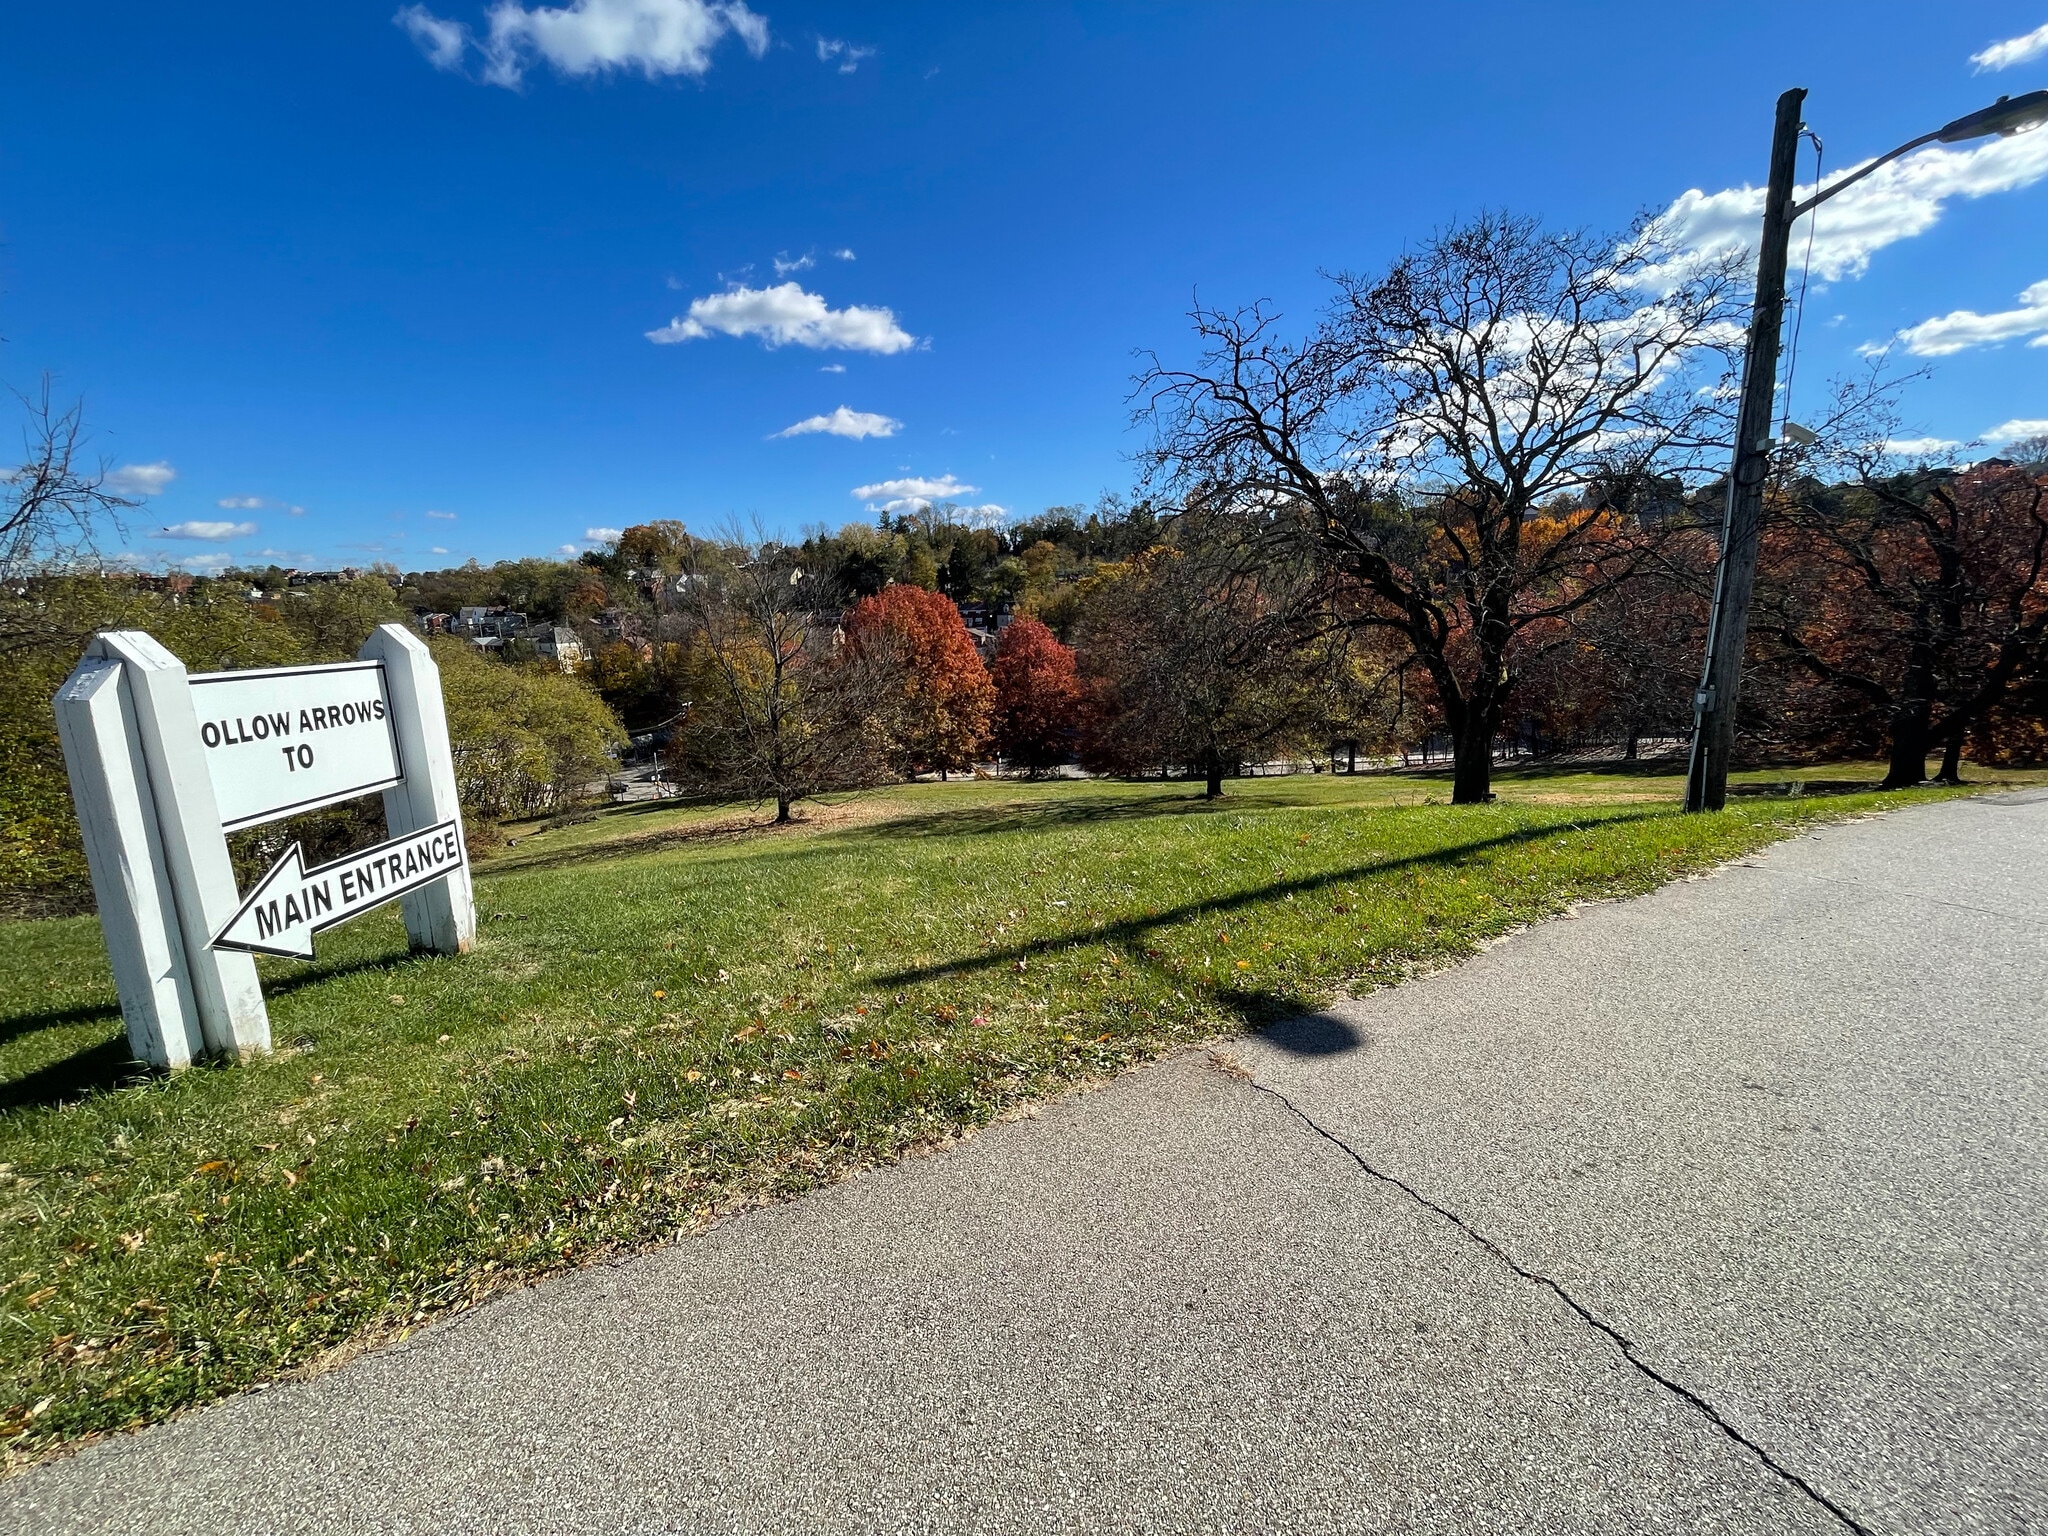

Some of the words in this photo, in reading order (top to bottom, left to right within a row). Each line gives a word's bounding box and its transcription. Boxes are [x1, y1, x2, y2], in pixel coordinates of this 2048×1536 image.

[201, 712, 290, 748] OLLOW
[299, 699, 385, 733] ARROWS
[282, 745, 314, 772] TO
[254, 880, 333, 941] MAIN
[339, 832, 457, 905] ENTRANCE
